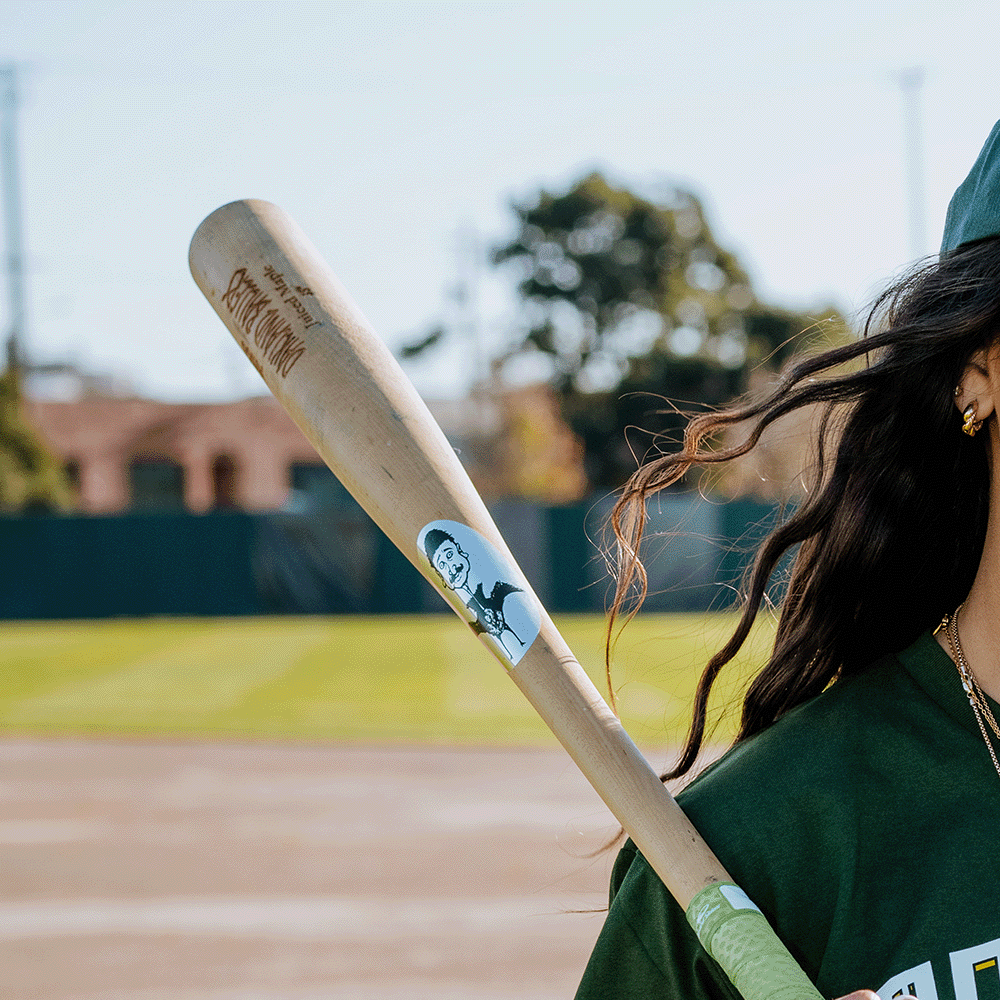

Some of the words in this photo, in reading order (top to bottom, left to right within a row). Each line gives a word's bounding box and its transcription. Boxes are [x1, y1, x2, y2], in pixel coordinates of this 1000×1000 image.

[262, 264, 293, 298] Maple
[284, 296, 323, 330] Juiced
[254, 308, 307, 379] OAKLAND
